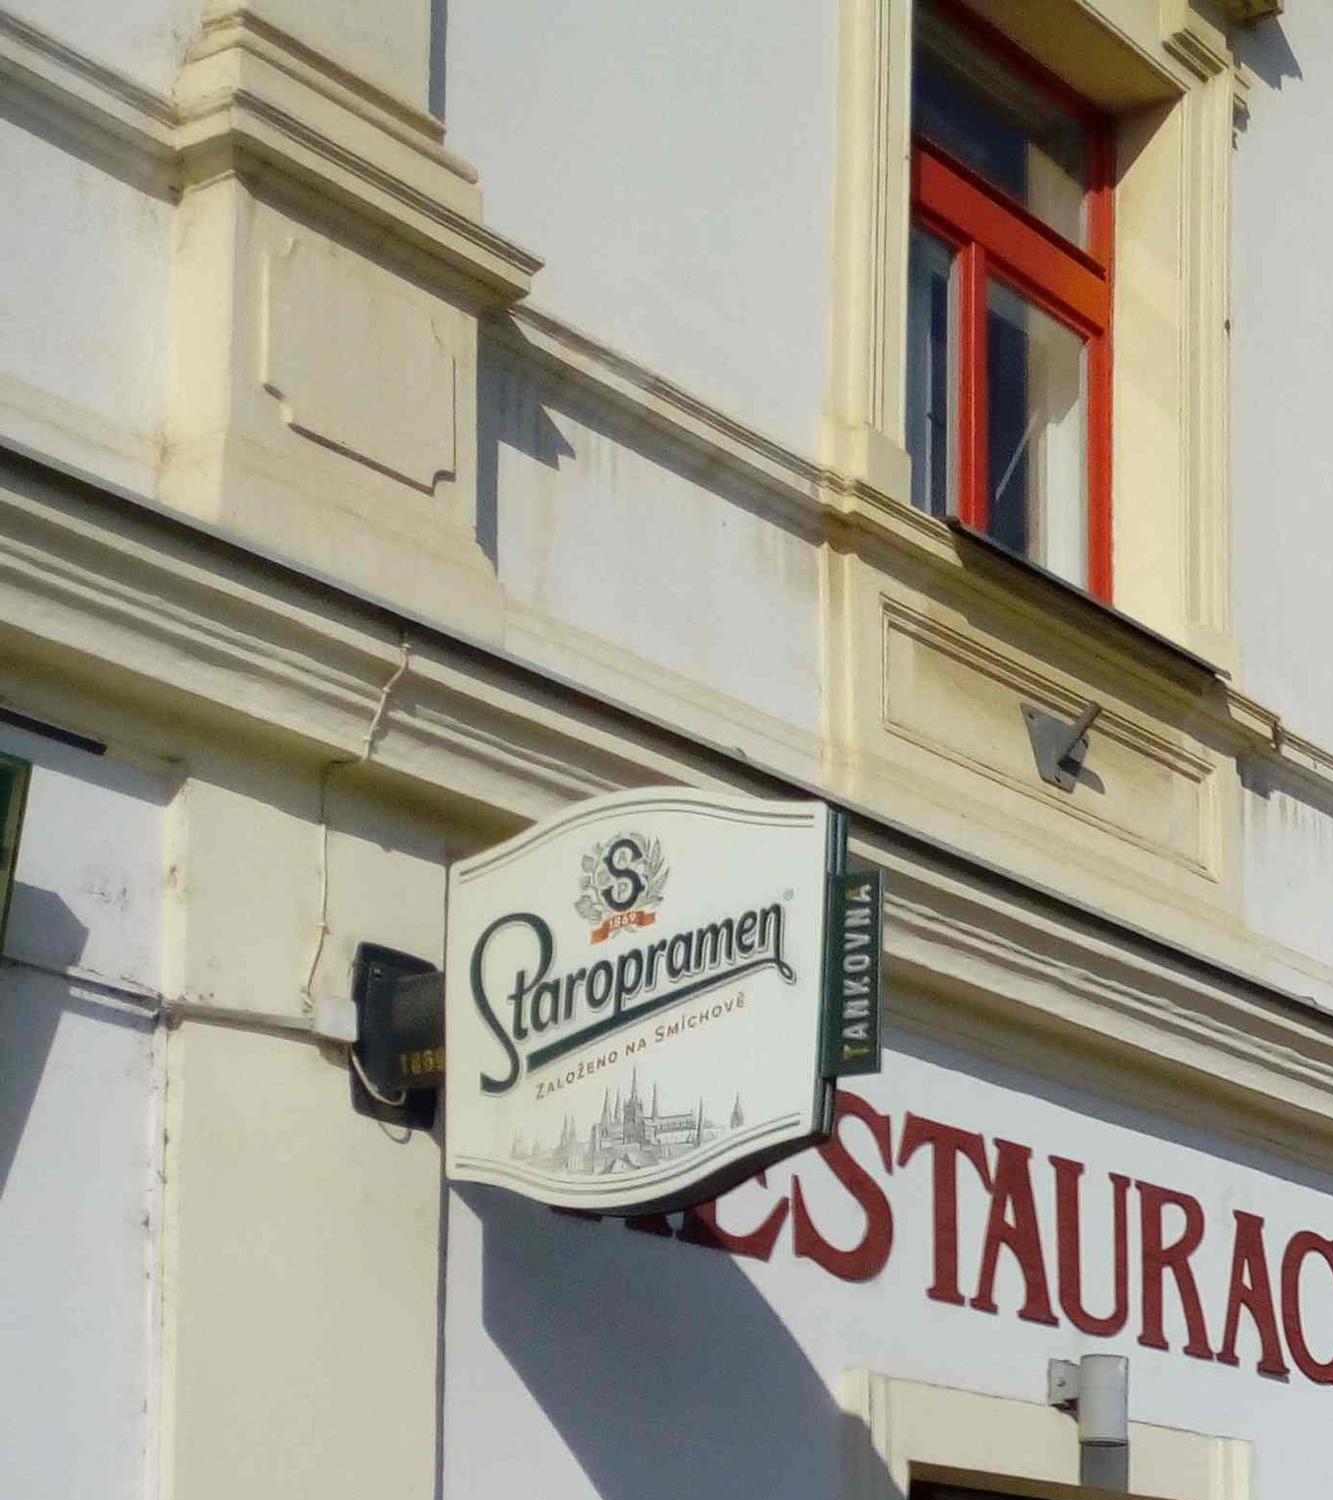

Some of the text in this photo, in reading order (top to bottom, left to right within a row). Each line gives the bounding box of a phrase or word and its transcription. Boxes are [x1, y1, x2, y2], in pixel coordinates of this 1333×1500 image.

[471, 903, 796, 1094] Staropramen
[842, 882, 873, 1062] TANKOVNA
[535, 1051, 619, 1100] ZALOŽENO
[624, 1037, 648, 1056] NA
